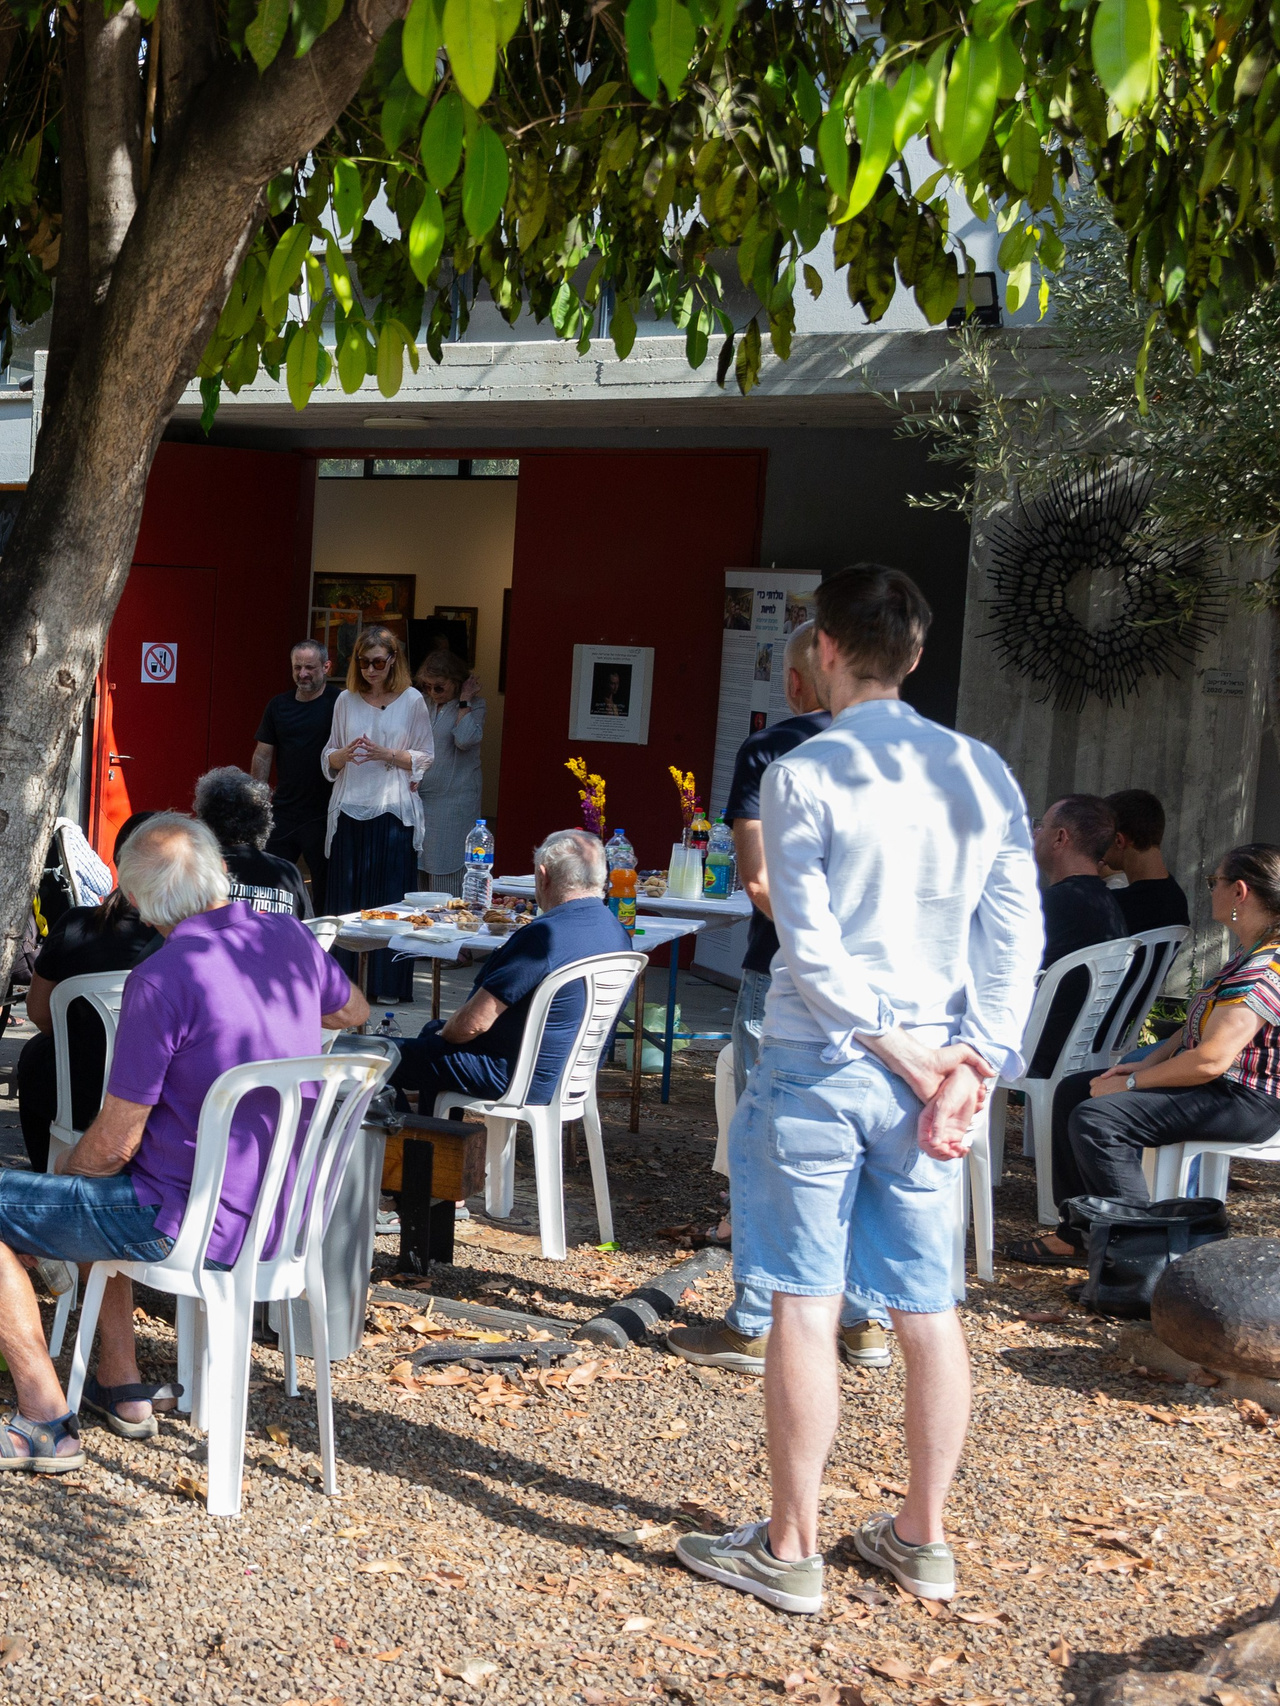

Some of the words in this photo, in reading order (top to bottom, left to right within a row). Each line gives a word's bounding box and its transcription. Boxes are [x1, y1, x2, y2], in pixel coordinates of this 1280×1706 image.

[756, 590, 765, 599] כדי
[760, 603, 776, 614] לחיות
[238, 883, 279, 901] המשפחות
